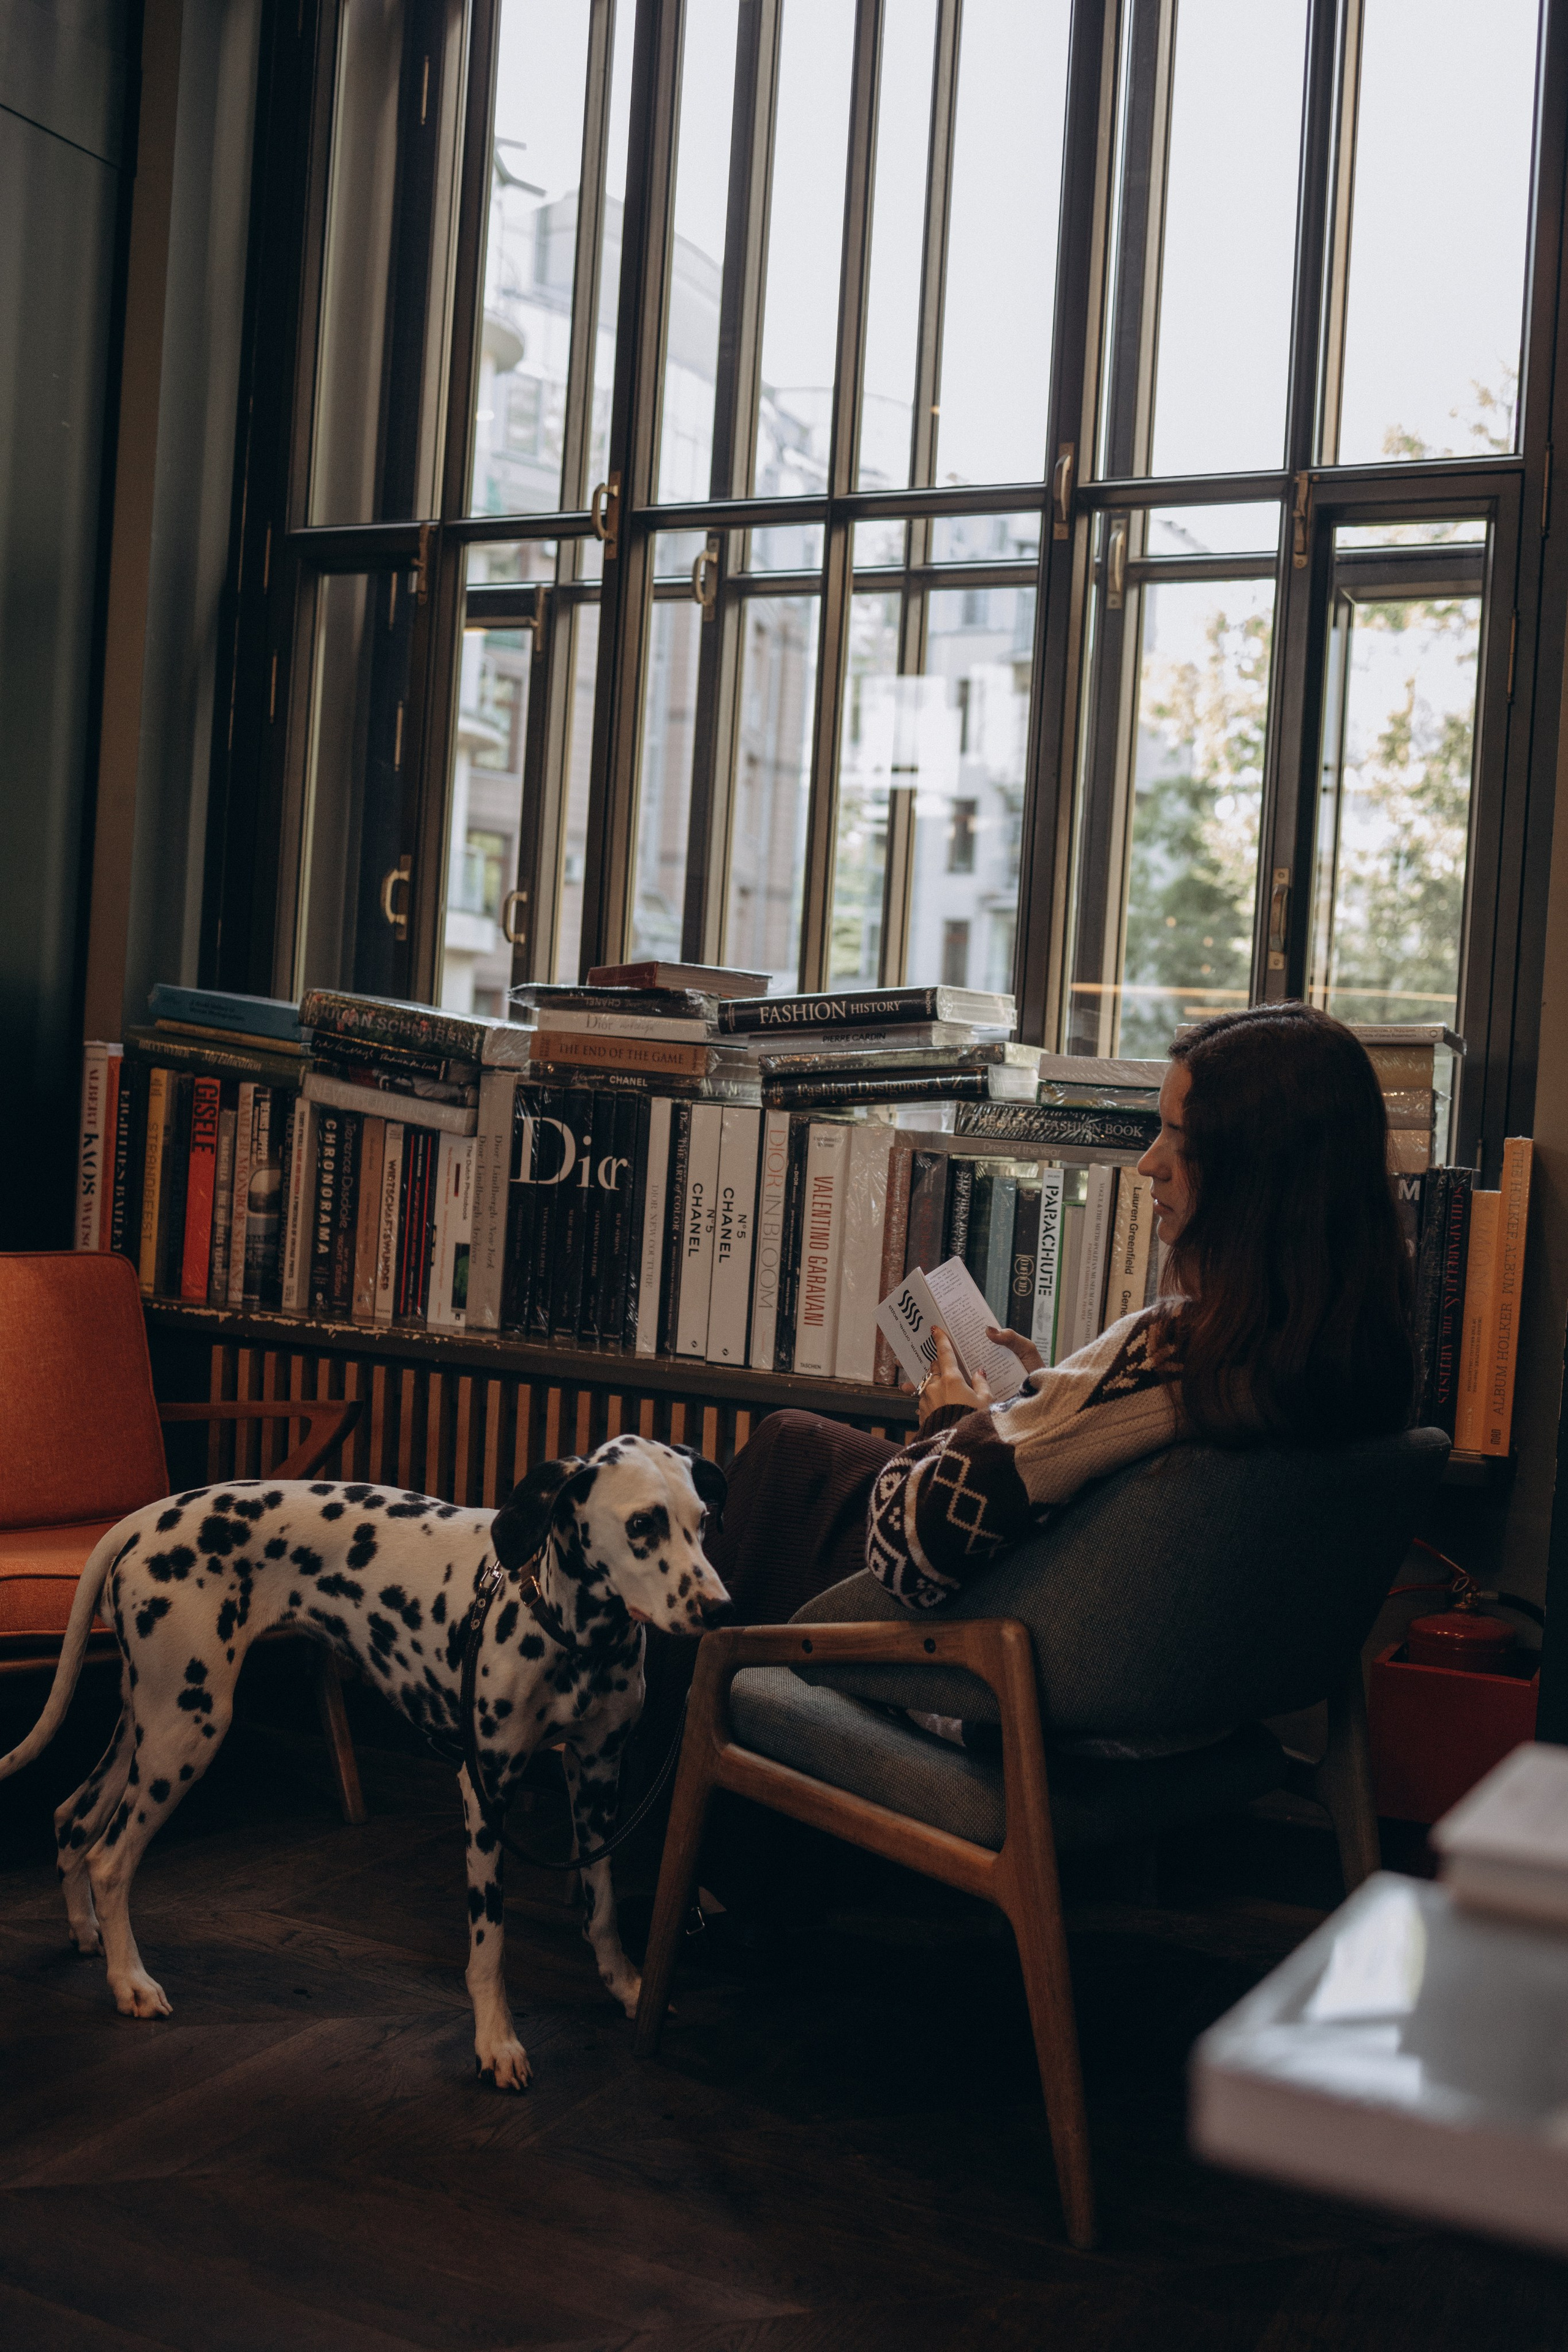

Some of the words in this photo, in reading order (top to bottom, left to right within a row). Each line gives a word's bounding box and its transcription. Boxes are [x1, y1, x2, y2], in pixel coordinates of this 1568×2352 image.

[587, 998, 622, 1008] CHANEL
[759, 1001, 847, 1025] FASHION
[851, 1000, 900, 1014] HISTORY
[317, 1004, 374, 1028] JULIAN
[376, 1016, 470, 1047] SCHNABEL
[587, 1014, 613, 1031] Dior
[823, 1034, 850, 1043] PIERRE
[851, 1031, 886, 1041] CARDIN
[559, 1042, 579, 1055] THE
[583, 1046, 606, 1058] END
[610, 1047, 625, 1059] OF
[627, 1049, 648, 1061] THE
[654, 1052, 685, 1065] GAME
[86, 1068, 99, 1129] ALBERT
[609, 1076, 649, 1087] CHANEL
[797, 1082, 851, 1096] Fashion
[858, 1079, 929, 1098] Designers
[117, 1090, 130, 1179] EIGHTIES
[193, 1084, 217, 1155] GISELE
[968, 1115, 995, 1127] THE
[1044, 1118, 1101, 1133] FASHION
[1105, 1123, 1144, 1137] BOOK
[81, 1133, 100, 1195] KAOS
[342, 1123, 355, 1174] Terence
[477, 1136, 487, 1159] Dior
[493, 1135, 503, 1158] Dior
[509, 1115, 628, 1191] Dior
[677, 1138, 687, 1159] THE
[766, 1129, 786, 1187] DIOR
[983, 1142, 1009, 1155] Dress
[1011, 1144, 1022, 1155] of
[1023, 1145, 1038, 1155] the
[1039, 1147, 1061, 1158] Year
[1511, 1150, 1525, 1177] THE
[142, 1123, 159, 1243] STRANDBEEST
[233, 1157, 248, 1225] MONROE
[318, 1119, 336, 1254] CHRONORAMA
[674, 1184, 683, 1194] of
[676, 1162, 685, 1182] ART
[339, 1176, 353, 1228] Disdale
[462, 1183, 471, 1220] Photobook
[474, 1166, 486, 1219] Lindbergh
[490, 1165, 502, 1218] Lindbergh
[650, 1185, 659, 1210] DIOR
[764, 1194, 782, 1216] IN
[959, 1172, 971, 1219] STEPHEN
[1129, 1187, 1141, 1221] Lauren
[1507, 1182, 1522, 1238] HOLKER
[113, 1185, 126, 1250] BAILEY
[380, 1159, 397, 1291] WIRTSCHAFTSWUNDER
[649, 1213, 657, 1237] NEW
[672, 1196, 682, 1231] COLOR
[688, 1183, 703, 1257] CHANEL
[720, 1187, 734, 1263] CHANEL
[810, 1176, 833, 1250] VALENTINO
[336, 1233, 345, 1261] YACHT
[471, 1226, 481, 1264] Archives
[488, 1224, 497, 1245] New
[957, 1222, 969, 1255] JONES
[996, 1226, 1007, 1259] Together
[1039, 1186, 1058, 1295] PARACHUTE
[1091, 1224, 1101, 1271] METROPOLITAN
[1125, 1224, 1138, 1275] Greenfield
[1446, 1185, 1464, 1292] SCHIAPARELLI
[486, 1248, 496, 1269] York
[645, 1239, 655, 1287] COUTURE
[758, 1223, 778, 1308] BLOOM
[1503, 1245, 1517, 1294] ALBUM
[333, 1264, 343, 1296] DESIGN
[804, 1256, 827, 1327] GARAVANI
[887, 1304, 900, 1321] вода
[1444, 1296, 1461, 1310] &
[896, 1321, 911, 1341] огонь,
[1442, 1314, 1452, 1335] THE
[1498, 1304, 1512, 1361] HOLKER
[908, 1341, 925, 1364] земля,
[1438, 1343, 1453, 1405] ARTISTS
[1493, 1366, 1508, 1416] ALBUM
